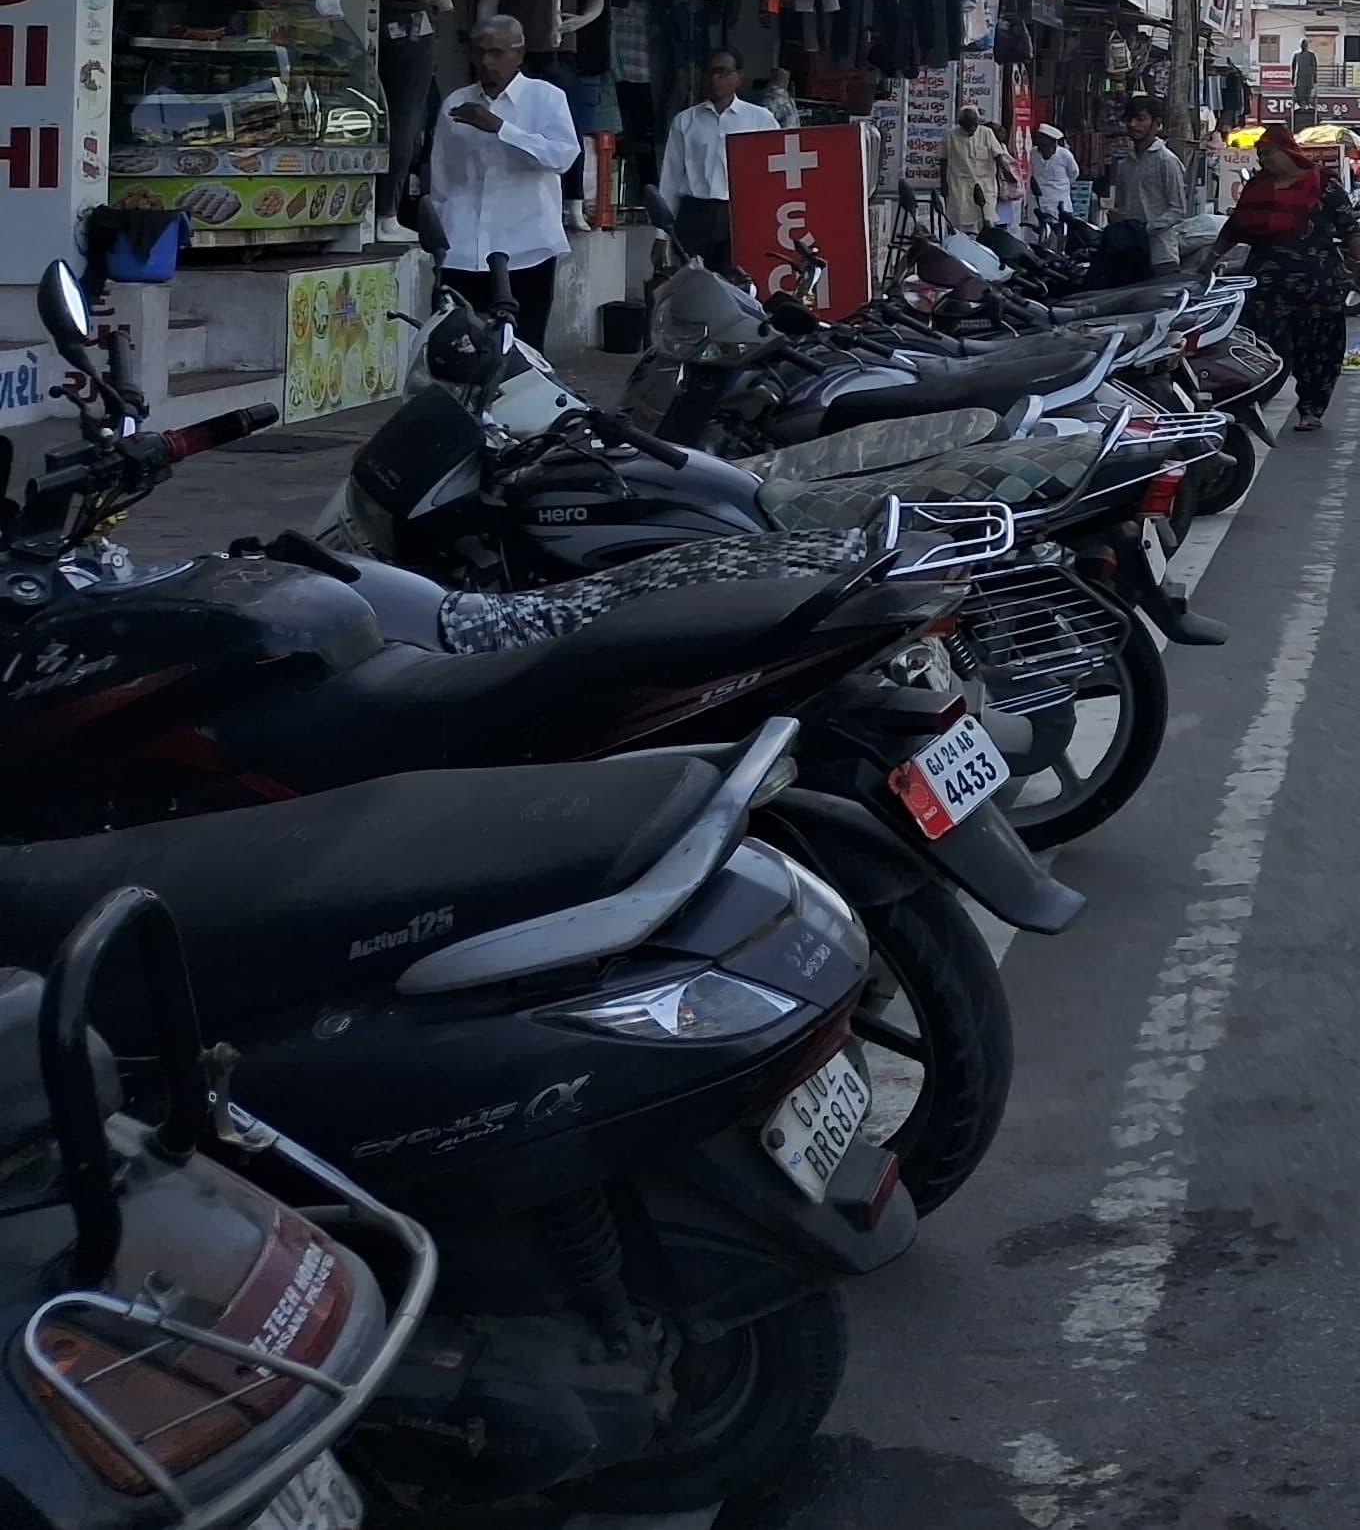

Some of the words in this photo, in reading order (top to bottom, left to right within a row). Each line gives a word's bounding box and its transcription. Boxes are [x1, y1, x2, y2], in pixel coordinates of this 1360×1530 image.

[925, 751, 946, 777] GJ
[940, 741, 960, 766] 24
[955, 730, 976, 754] AB
[944, 751, 998, 807] 4433
